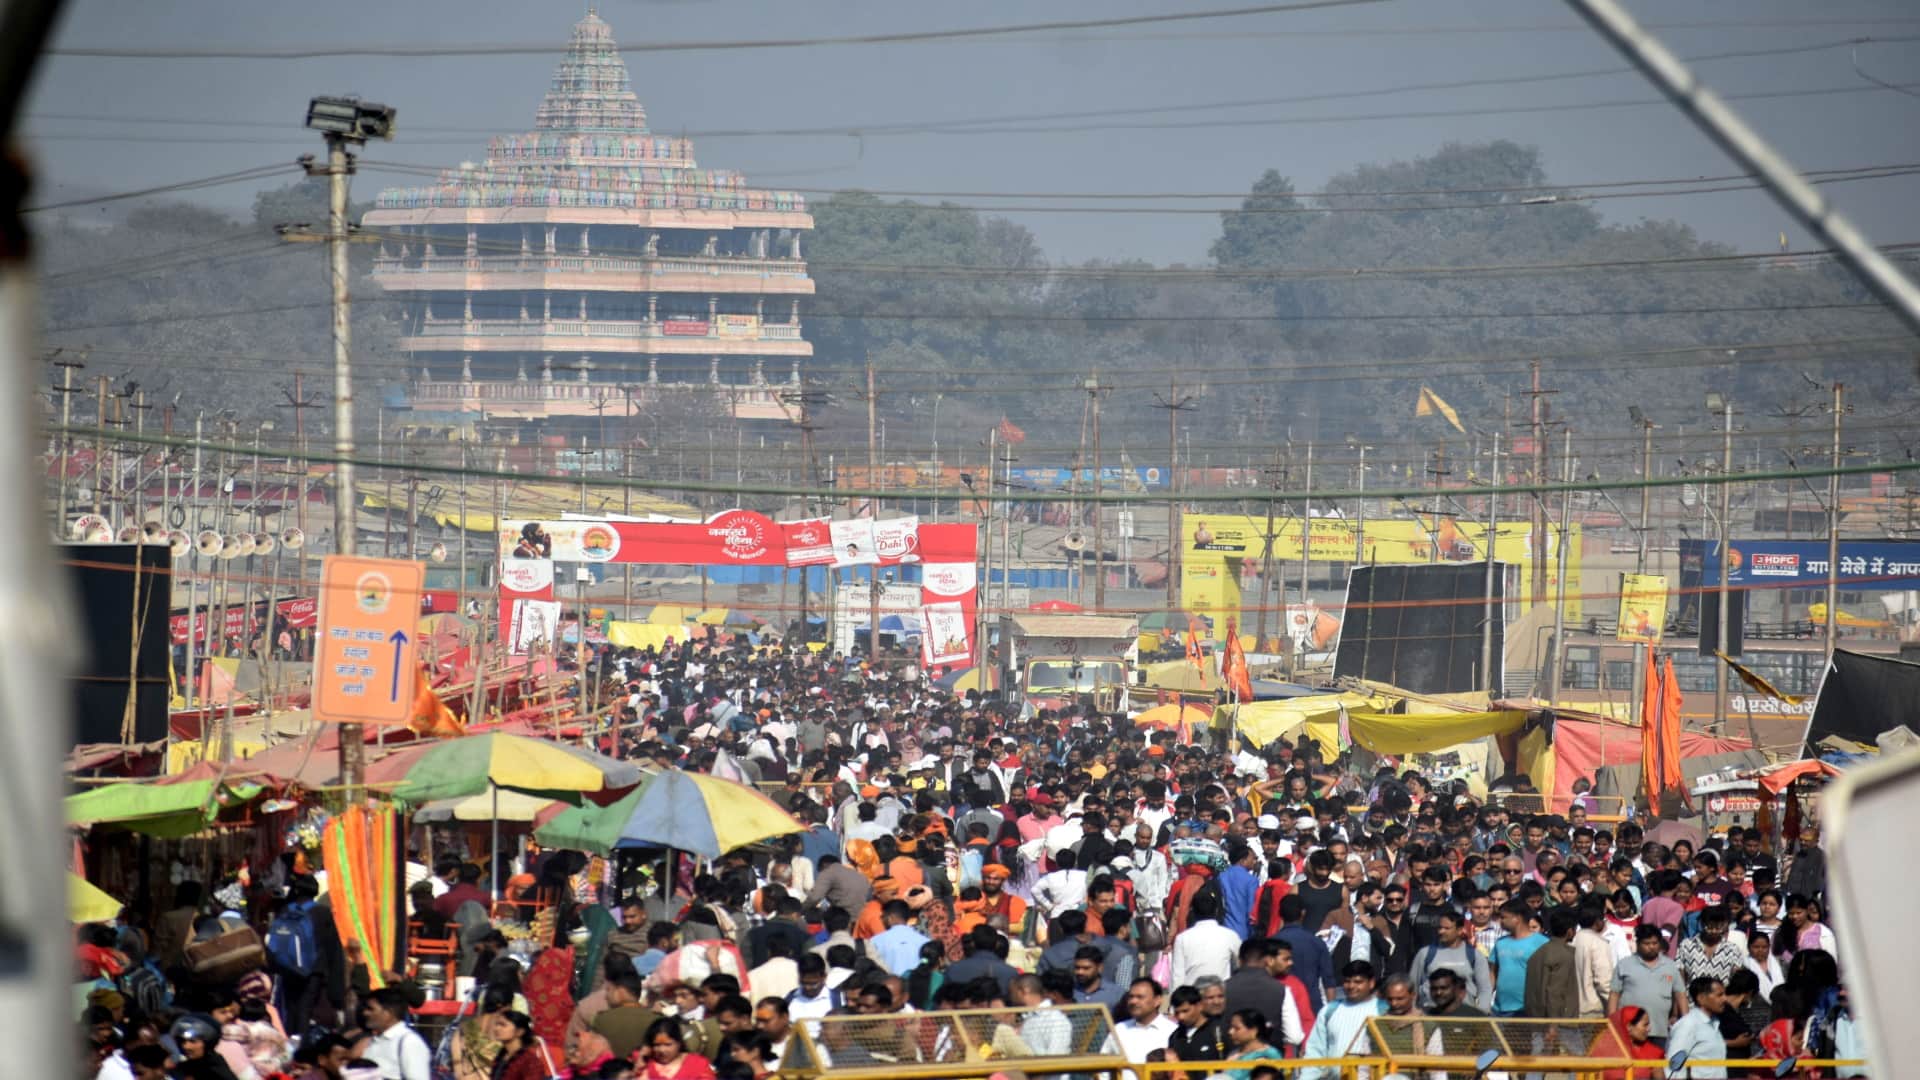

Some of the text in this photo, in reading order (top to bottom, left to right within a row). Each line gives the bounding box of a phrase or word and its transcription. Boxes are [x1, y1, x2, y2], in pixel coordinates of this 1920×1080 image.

[880, 540, 902, 550] Dahi
[1765, 556, 1795, 564] HDFC
[1841, 557, 1867, 575] मेले
[1870, 557, 1885, 576] में
